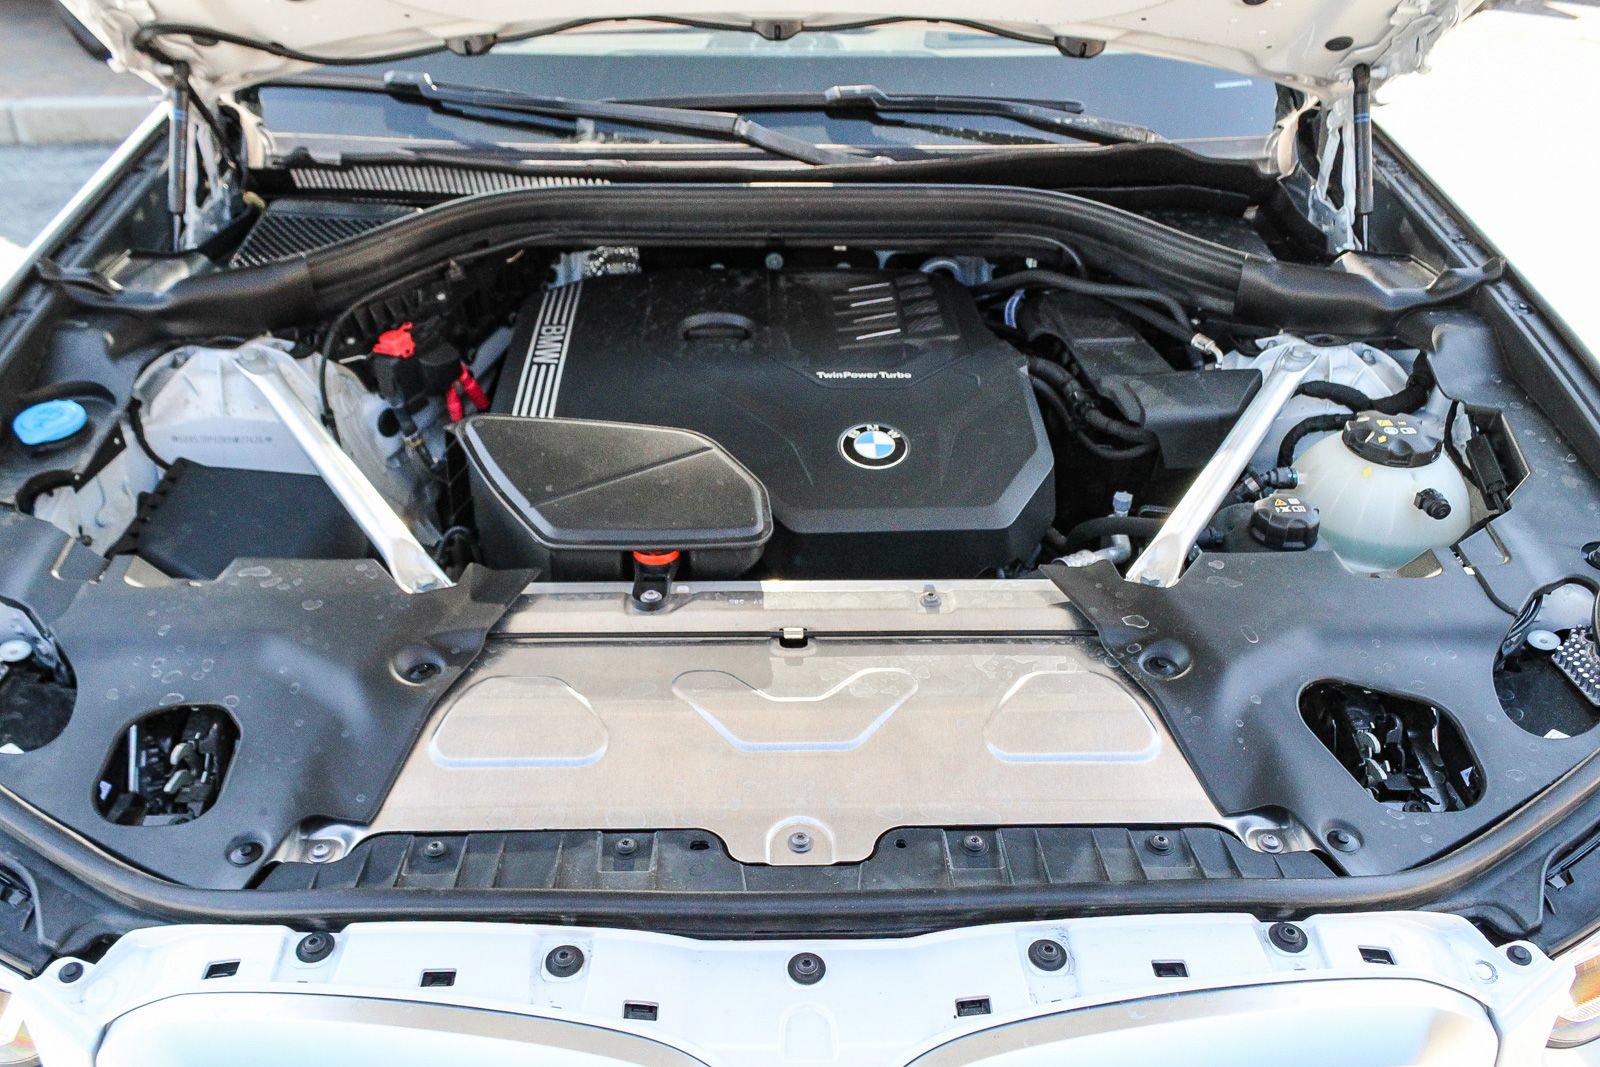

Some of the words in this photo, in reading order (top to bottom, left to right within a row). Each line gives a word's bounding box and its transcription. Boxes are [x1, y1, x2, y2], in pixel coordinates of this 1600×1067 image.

[532, 325, 566, 364] BMW
[816, 371, 878, 379] TwinPower
[879, 371, 912, 379] Turbo
[847, 424, 901, 439] BMW
